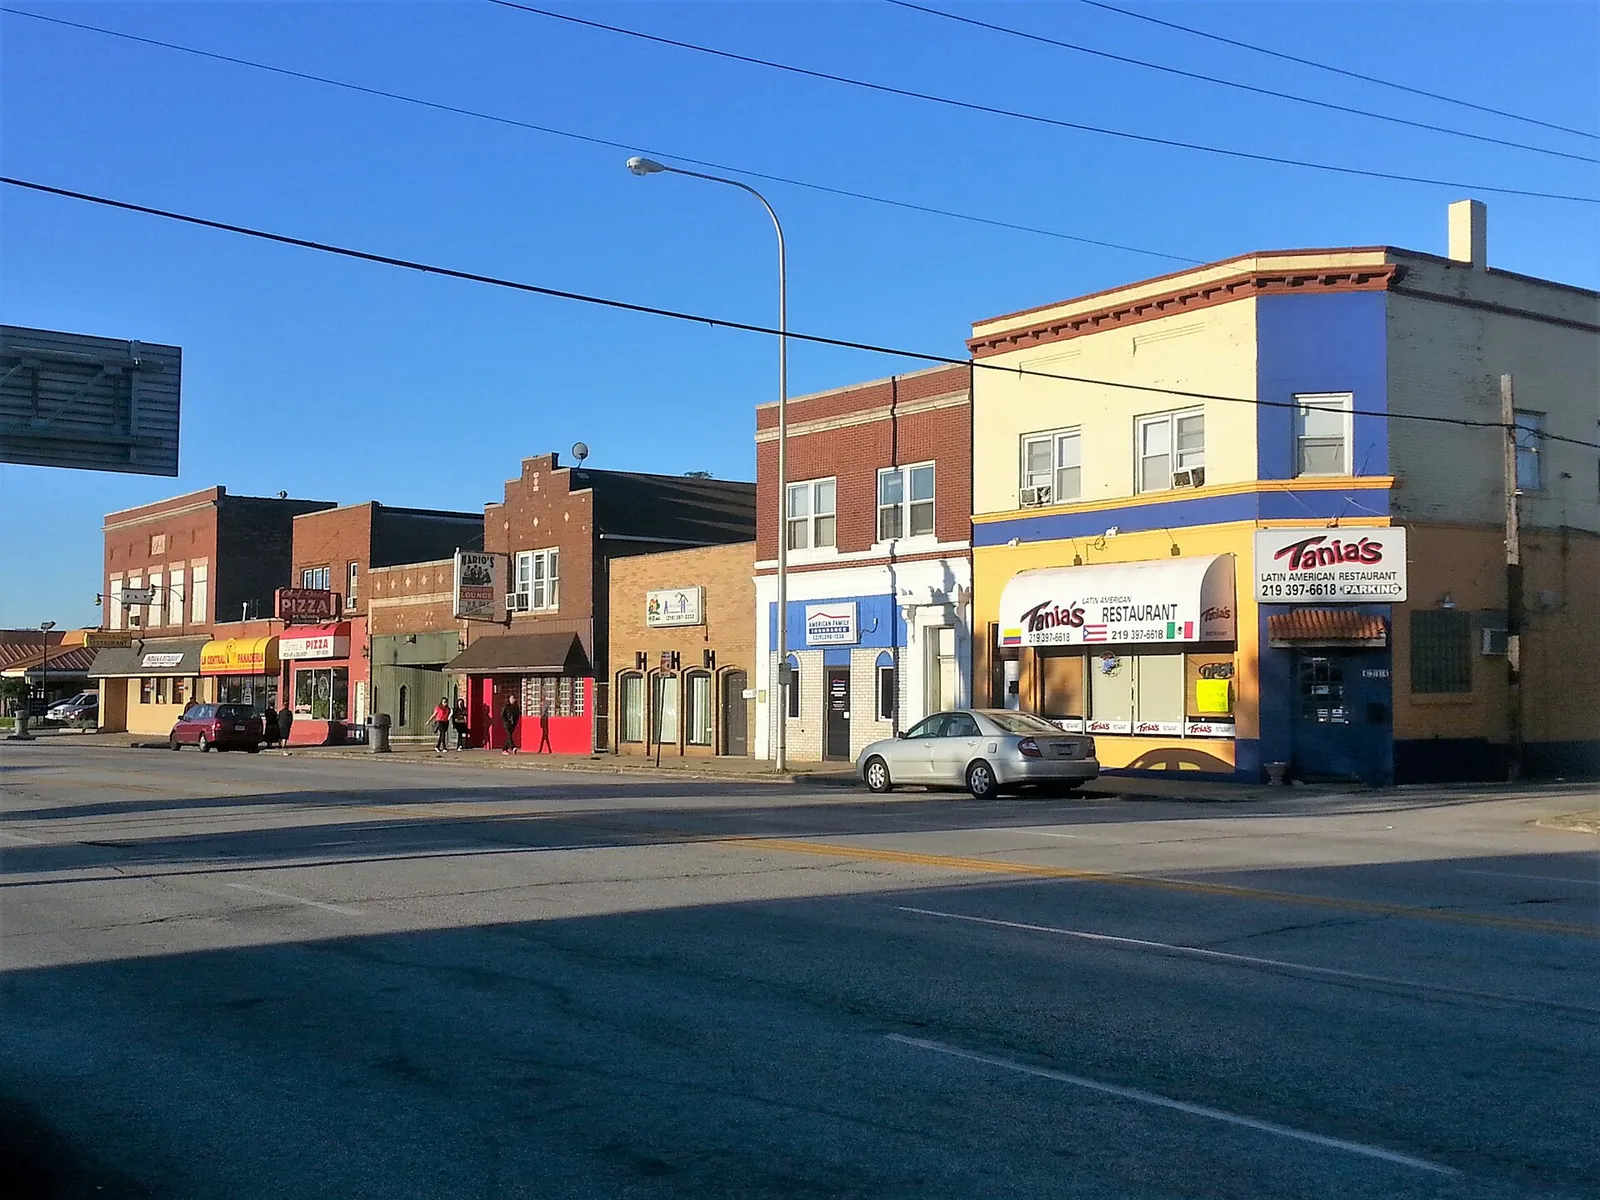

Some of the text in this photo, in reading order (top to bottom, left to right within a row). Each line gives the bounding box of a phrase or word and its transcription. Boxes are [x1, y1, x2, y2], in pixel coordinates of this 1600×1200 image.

[1274, 535, 1384, 571] Tania's
[1261, 571, 1397, 582] LATIN AMERICAN RESTAURANT
[1262, 584, 1337, 596] 219 397-6618
[1343, 584, 1401, 595] PARKING
[1082, 596, 1132, 605] LATIN AMERICAN
[281, 599, 329, 614] PIZZA
[1020, 600, 1086, 633] Tania's
[1102, 604, 1178, 622] RESTAURANT
[1200, 606, 1231, 622] Tania's
[1029, 633, 1071, 643] 219 397-6618
[1111, 629, 1164, 640] 219 397-6618
[306, 639, 329, 650] PIZZA
